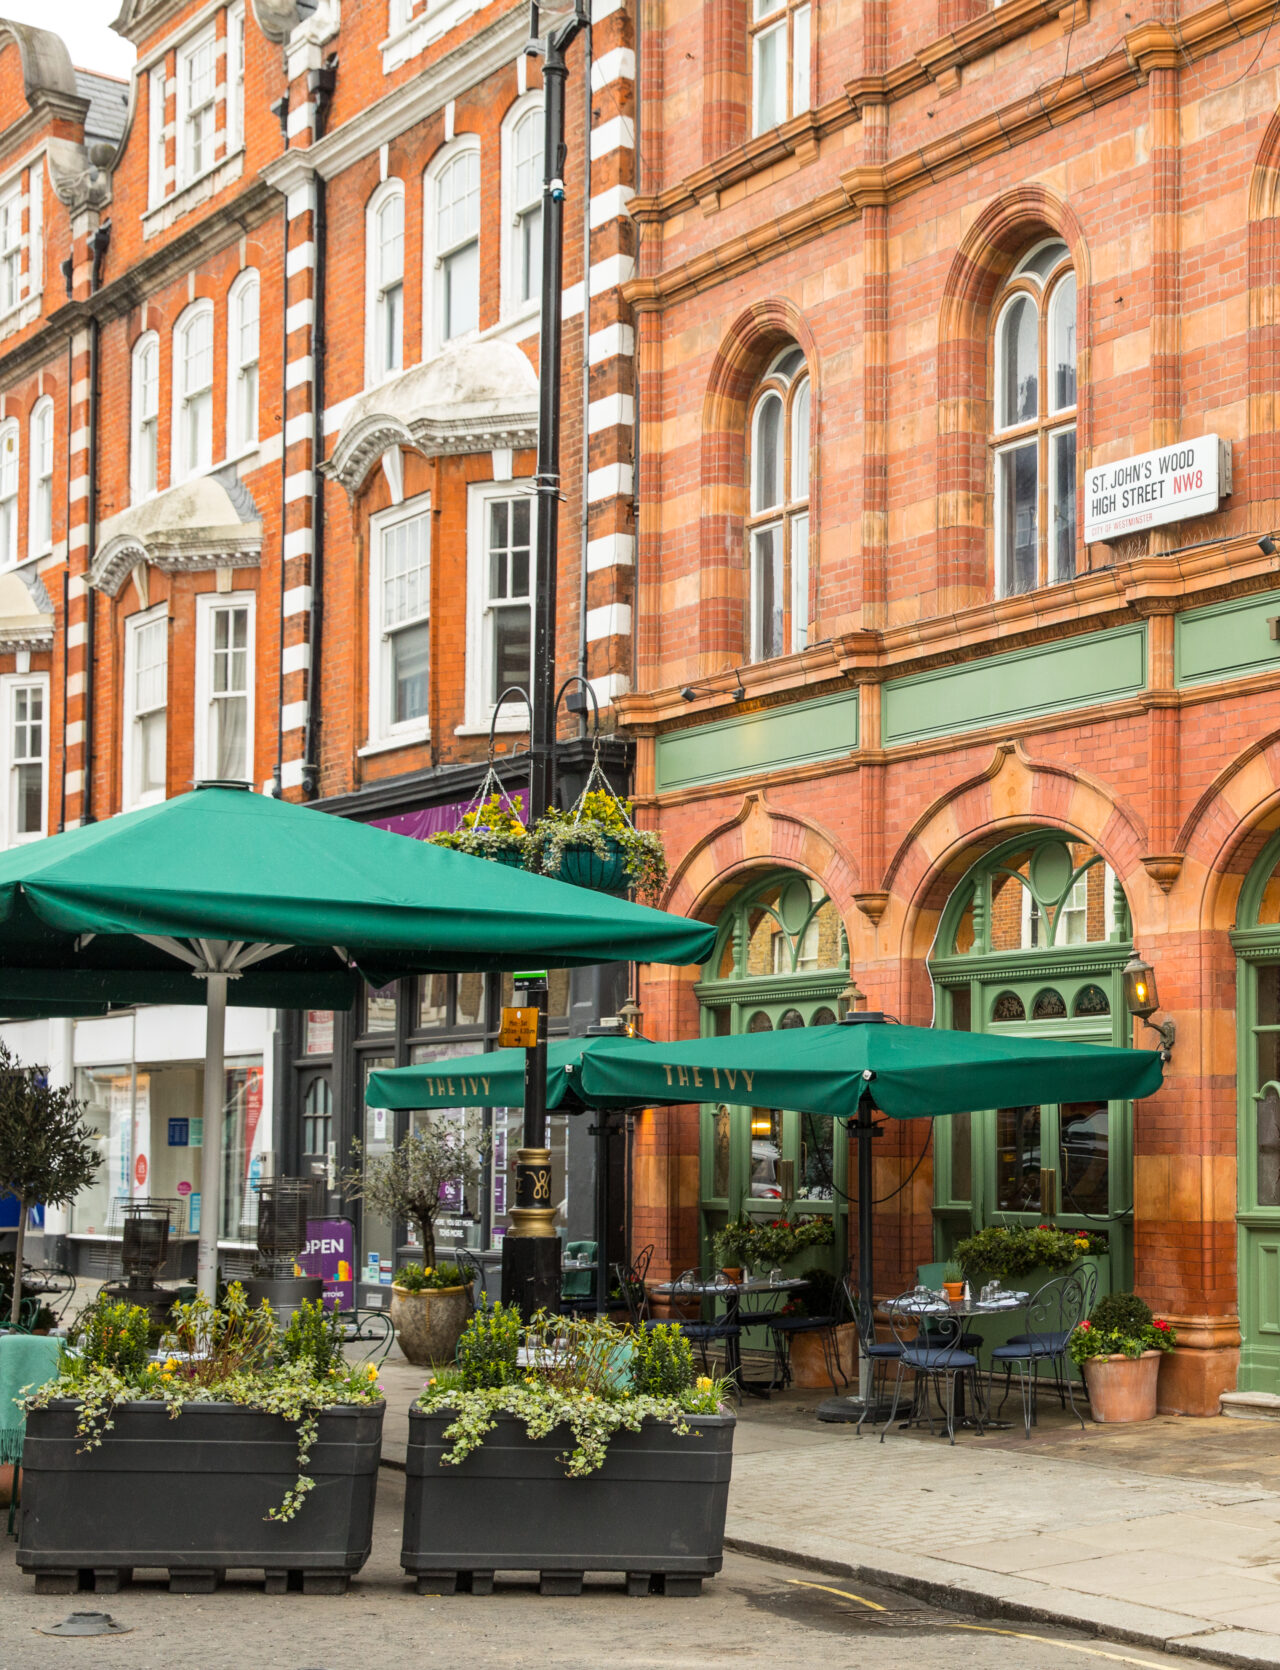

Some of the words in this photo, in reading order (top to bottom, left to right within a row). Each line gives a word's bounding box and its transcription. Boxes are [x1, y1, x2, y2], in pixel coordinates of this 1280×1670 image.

[1092, 473, 1108, 494] ST.
[1111, 460, 1152, 489] JOHN'S
[1159, 449, 1195, 475] WOOD
[1091, 494, 1116, 517] HIGH
[1122, 480, 1165, 508] STREET
[1173, 470, 1203, 495] NW8
[1091, 527, 1105, 536] CITY
[1105, 524, 1113, 533] OF
[1113, 512, 1153, 530] WESTMINSTER
[426, 1077, 455, 1096] THE
[461, 1076, 490, 1096] IVY
[662, 1064, 703, 1087] THE
[712, 1067, 755, 1092] IVY
